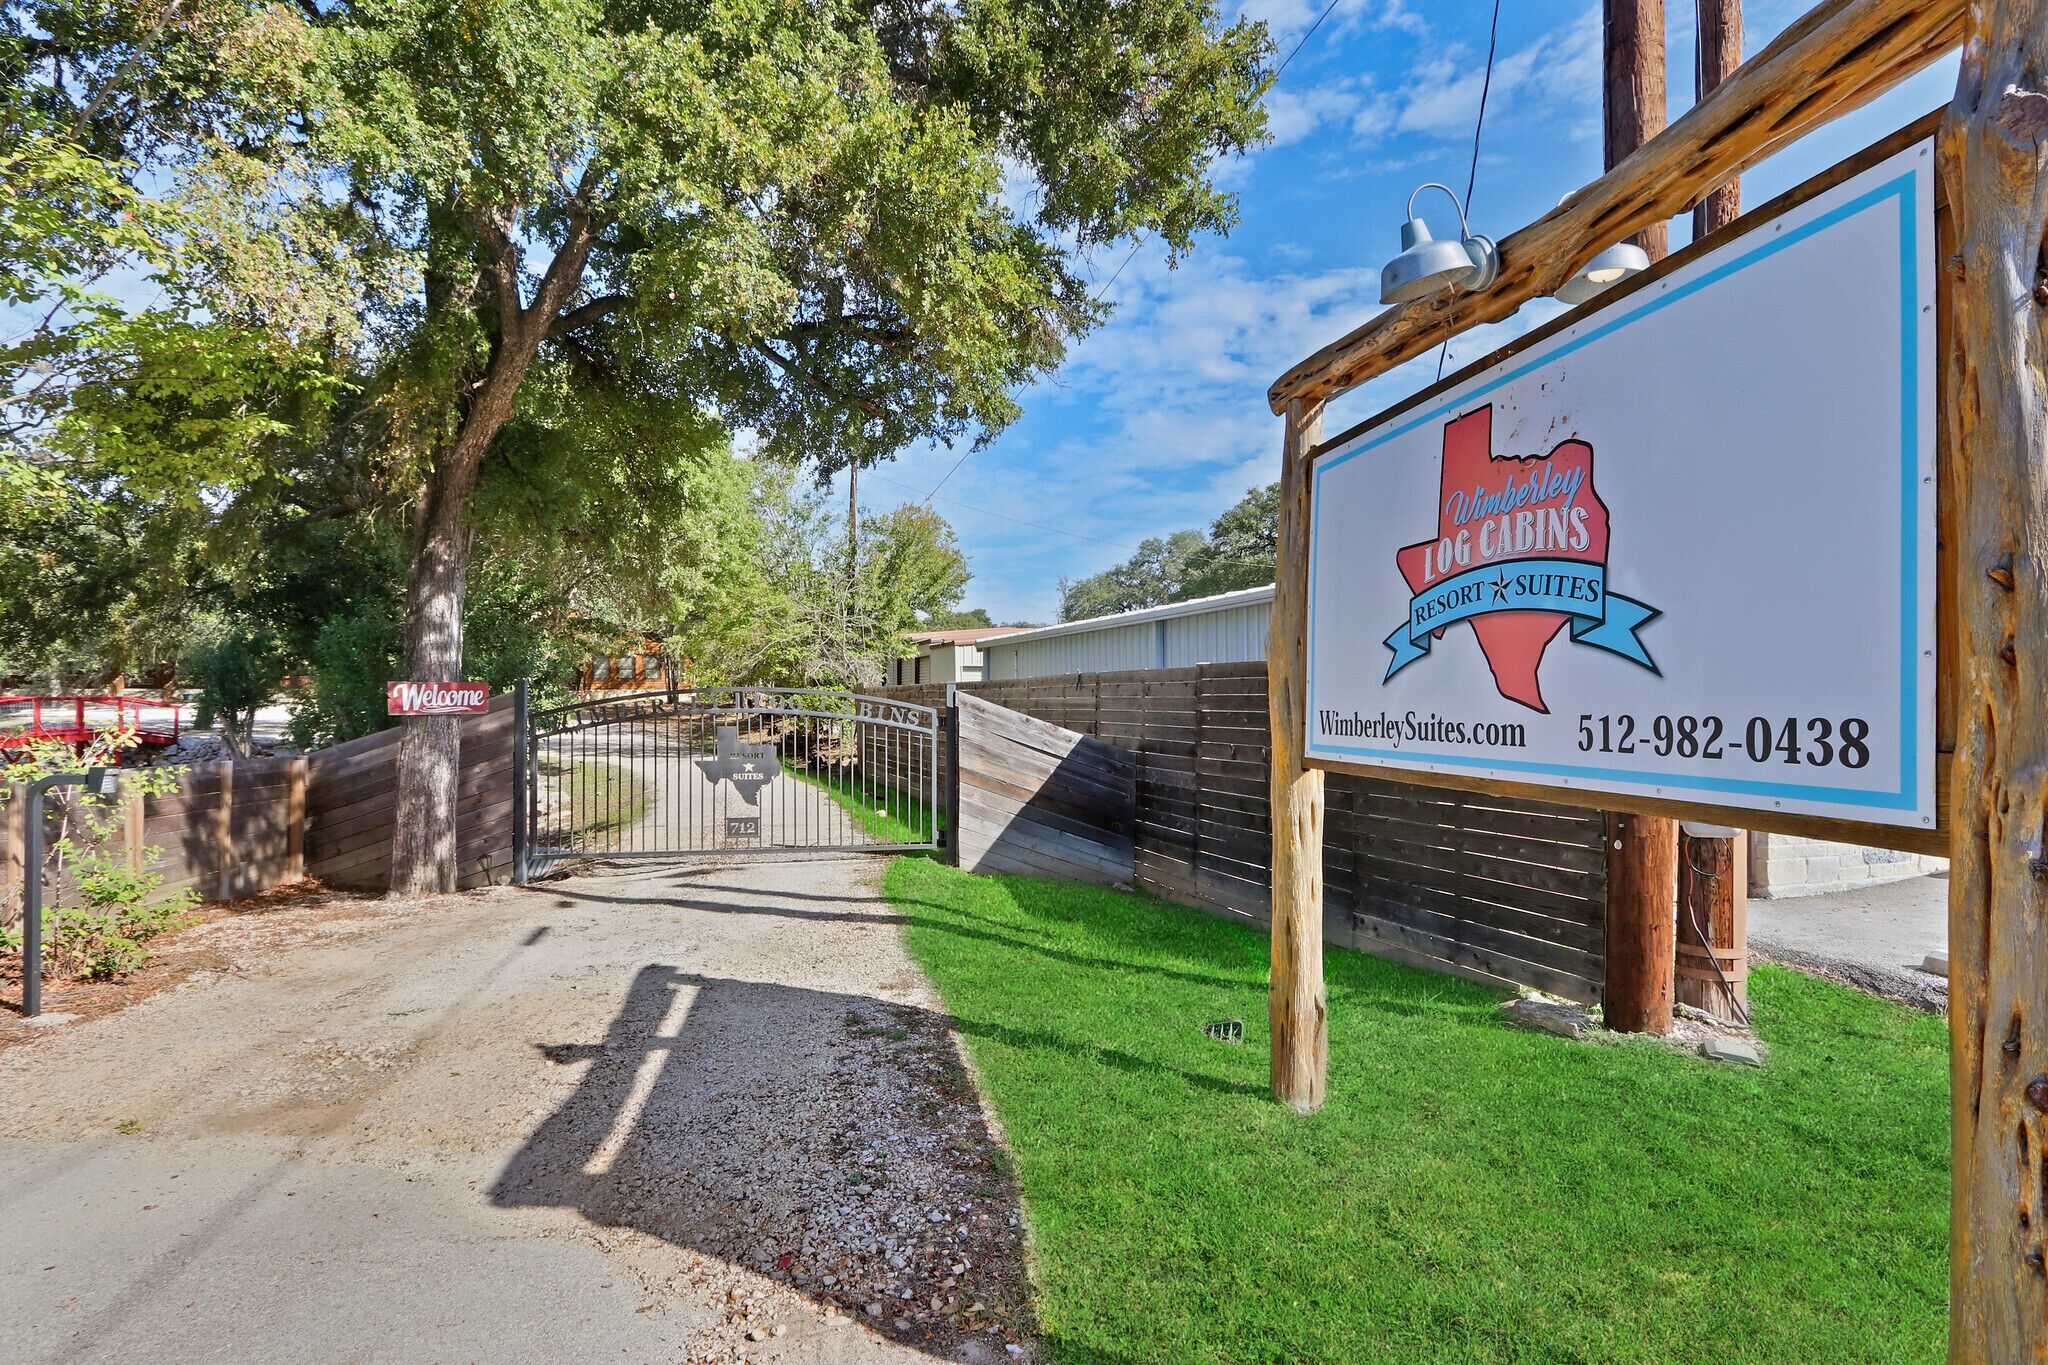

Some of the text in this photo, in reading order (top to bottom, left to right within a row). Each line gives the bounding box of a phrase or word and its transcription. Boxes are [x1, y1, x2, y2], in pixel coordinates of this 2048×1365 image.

[1445, 461, 1587, 527] Wimberley
[1424, 505, 1591, 584] LOG CABINS
[1414, 574, 1600, 626] RESORT SUITES
[393, 683, 485, 711] Welcome
[818, 699, 920, 727] CABINS
[1319, 710, 1527, 748] WimberleySuites.com
[1578, 714, 1871, 769] 512-982-0438
[730, 752, 765, 760] RESORT
[732, 772, 764, 780] SUITES
[730, 822, 756, 834] 712
